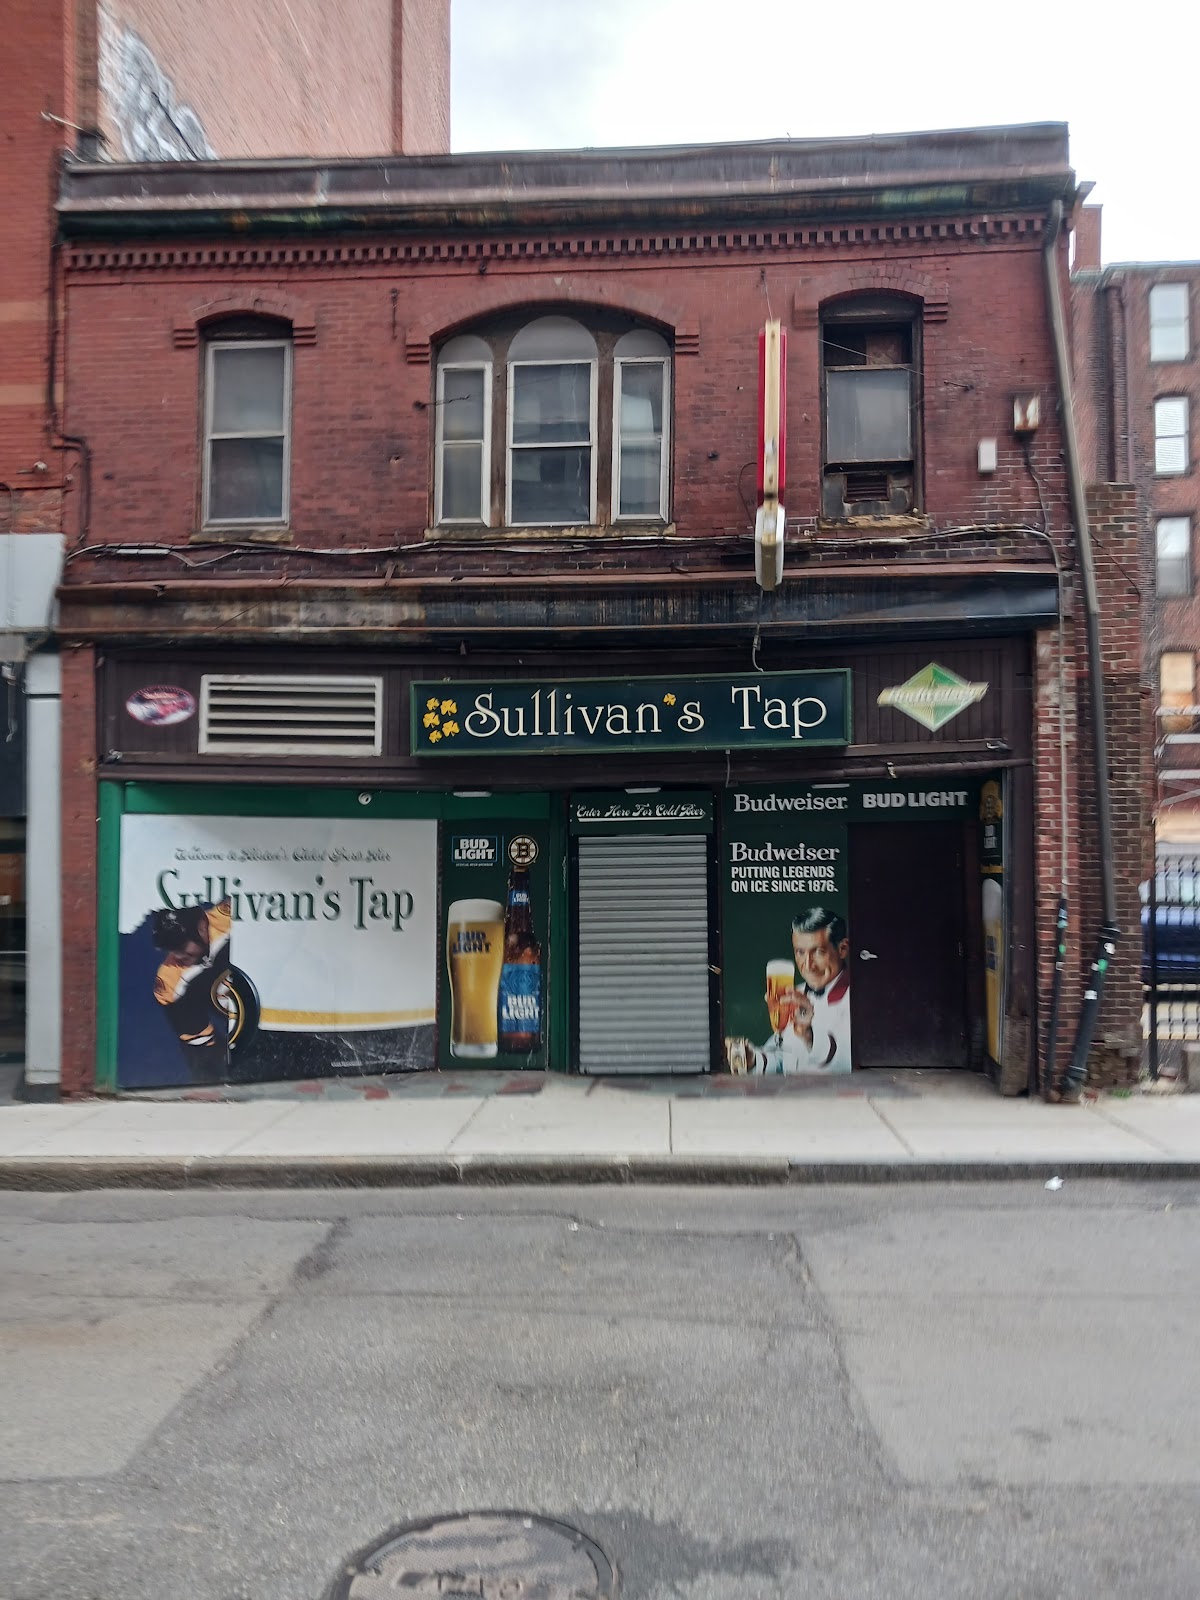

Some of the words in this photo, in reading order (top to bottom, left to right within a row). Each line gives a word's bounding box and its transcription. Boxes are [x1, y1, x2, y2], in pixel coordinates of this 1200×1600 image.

[464, 688, 705, 738] Sullivan's
[731, 684, 827, 739] Tap
[734, 793, 847, 812] Budweiser
[863, 793, 906, 808] BUD
[907, 791, 967, 807] LIGHT
[576, 804, 601, 818] Enter
[604, 804, 631, 817] Here
[632, 803, 653, 817] For
[655, 803, 680, 817] Cold
[679, 803, 704, 817] Beer
[460, 838, 489, 849] BUD
[454, 848, 495, 860] LIGHT
[729, 842, 840, 862] Budweiser
[731, 865, 780, 879] PUTTING
[782, 865, 835, 878] LEGENDS
[731, 881, 748, 893] ON
[750, 880, 769, 892] ICE
[771, 880, 806, 892] SINCE
[807, 879, 839, 892] 1876.
[349, 874, 414, 932] Tap
[508, 994, 537, 1007] BUD
[502, 1006, 540, 1020] LIGHT
